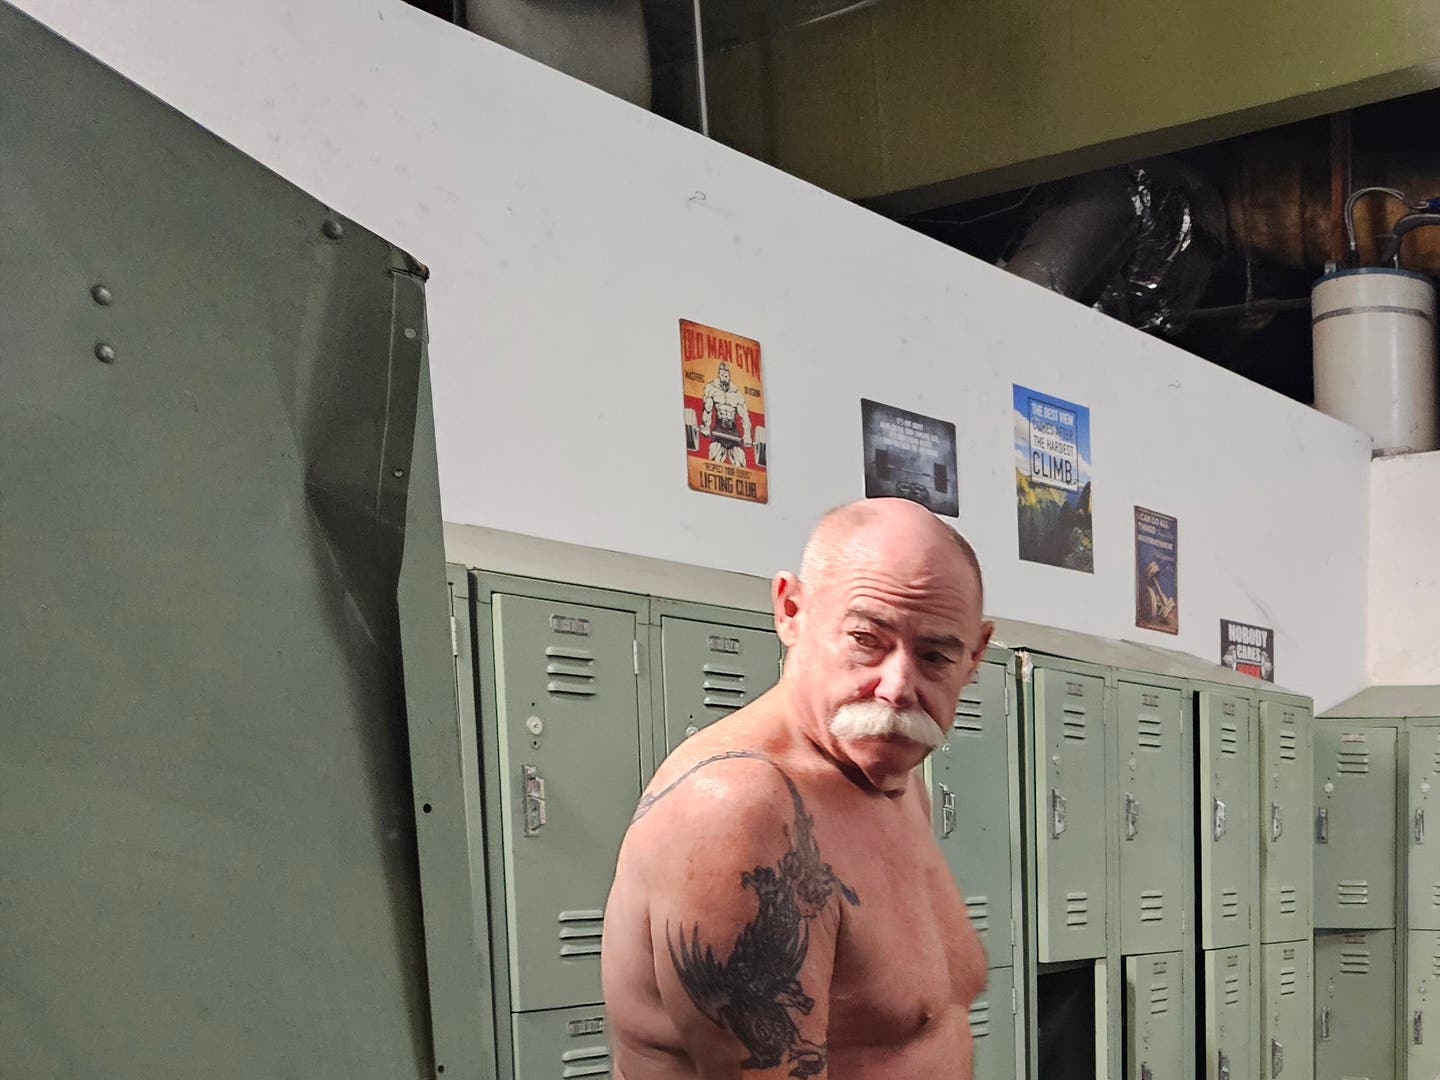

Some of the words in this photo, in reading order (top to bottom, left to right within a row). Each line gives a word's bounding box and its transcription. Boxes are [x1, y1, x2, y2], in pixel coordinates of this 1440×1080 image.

[684, 328, 705, 361] OLD
[707, 334, 732, 363] MAN
[735, 342, 760, 381] GYM
[1033, 434, 1045, 449] THE
[1046, 438, 1074, 457] HARDEST
[699, 471, 733, 493] LIFTING
[736, 479, 757, 498] CLUB
[1227, 623, 1268, 648] NOBODY
